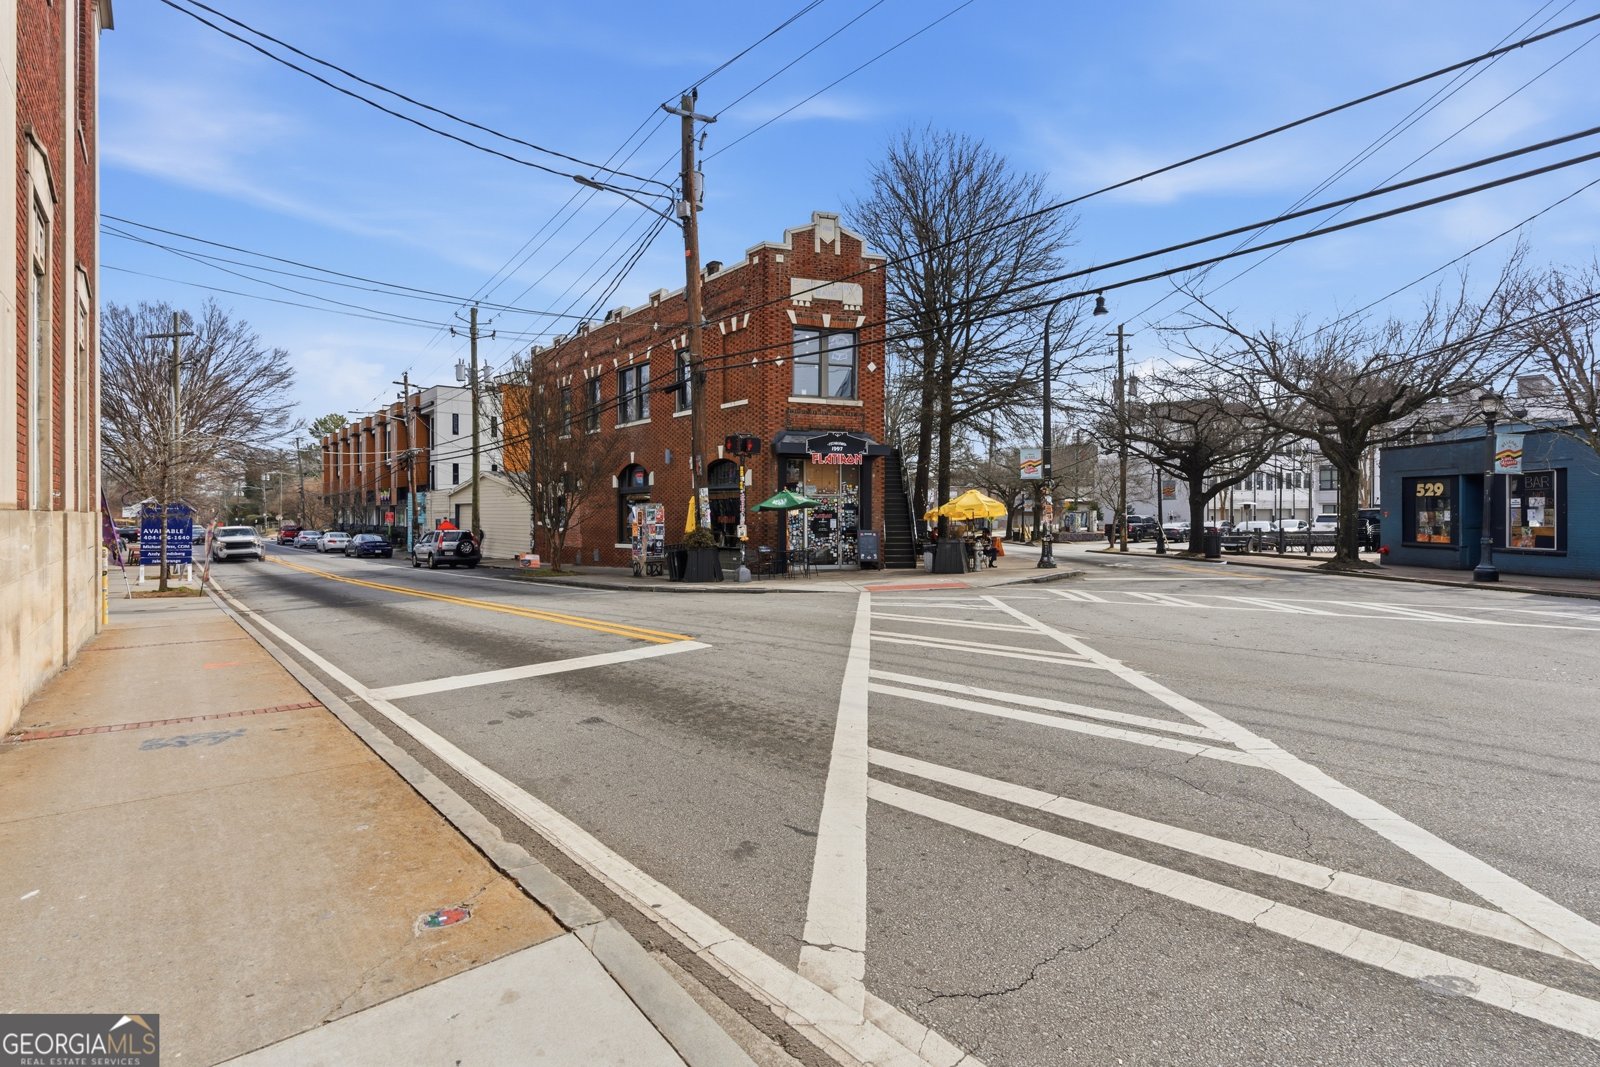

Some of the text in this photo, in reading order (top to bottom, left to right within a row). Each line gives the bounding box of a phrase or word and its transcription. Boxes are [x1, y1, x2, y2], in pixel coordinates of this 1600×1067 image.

[812, 453, 863, 465] FLATIRON
[1524, 475, 1550, 489] BAR
[1416, 482, 1444, 497] 529
